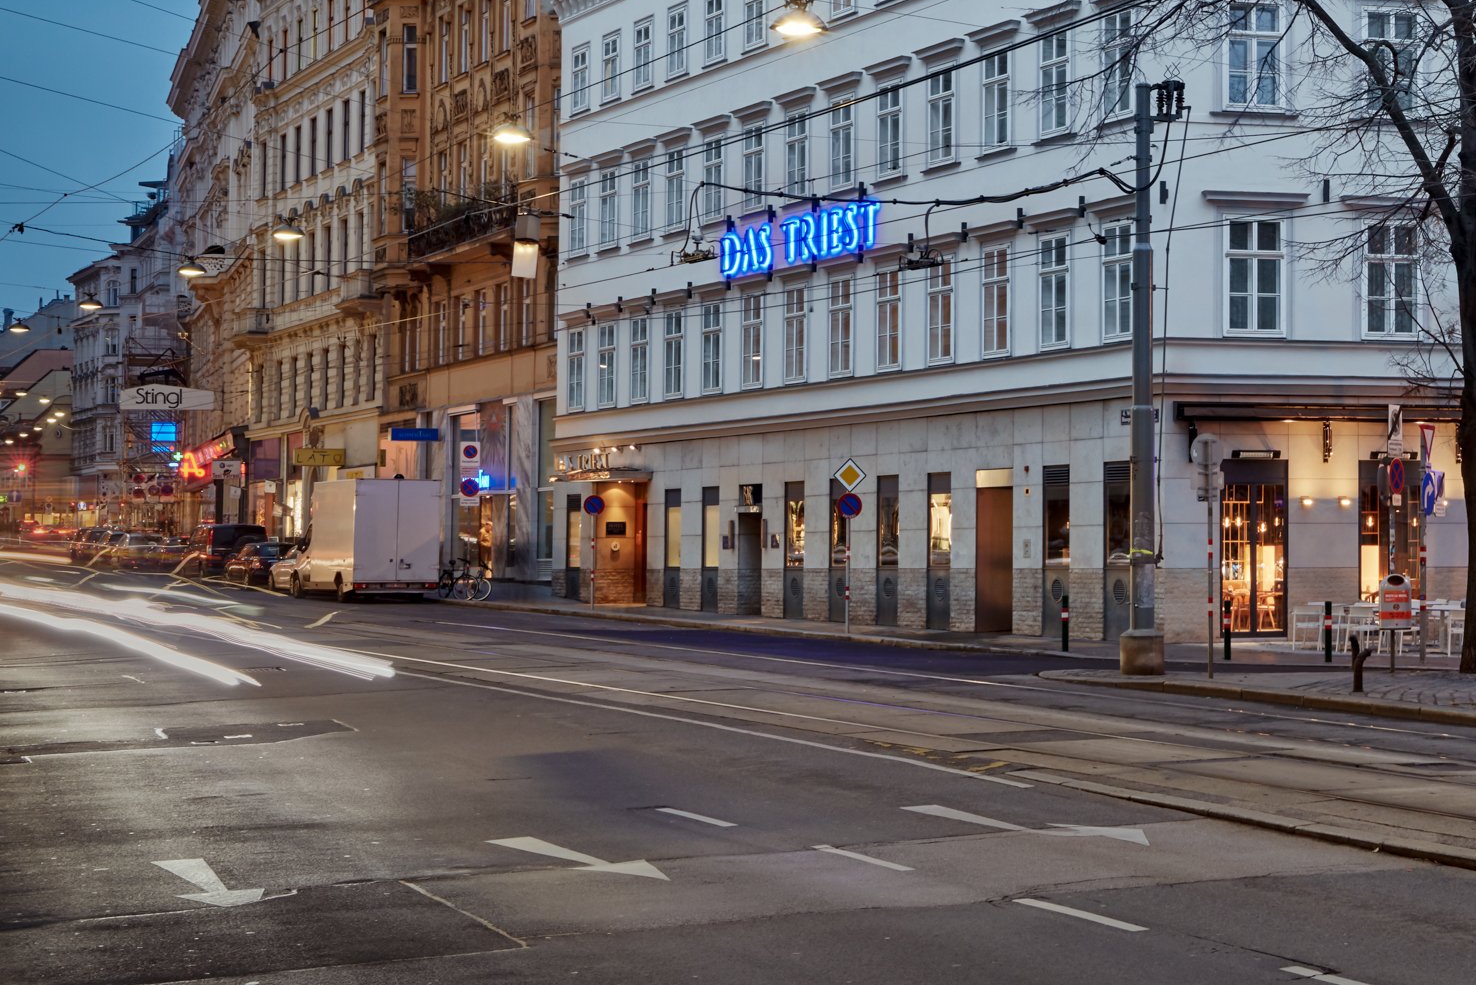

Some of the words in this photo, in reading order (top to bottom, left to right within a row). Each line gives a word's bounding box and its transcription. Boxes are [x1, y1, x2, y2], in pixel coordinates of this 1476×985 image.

[720, 222, 771, 277] DAS
[780, 200, 881, 263] TRIEST
[135, 388, 182, 409] Stingl
